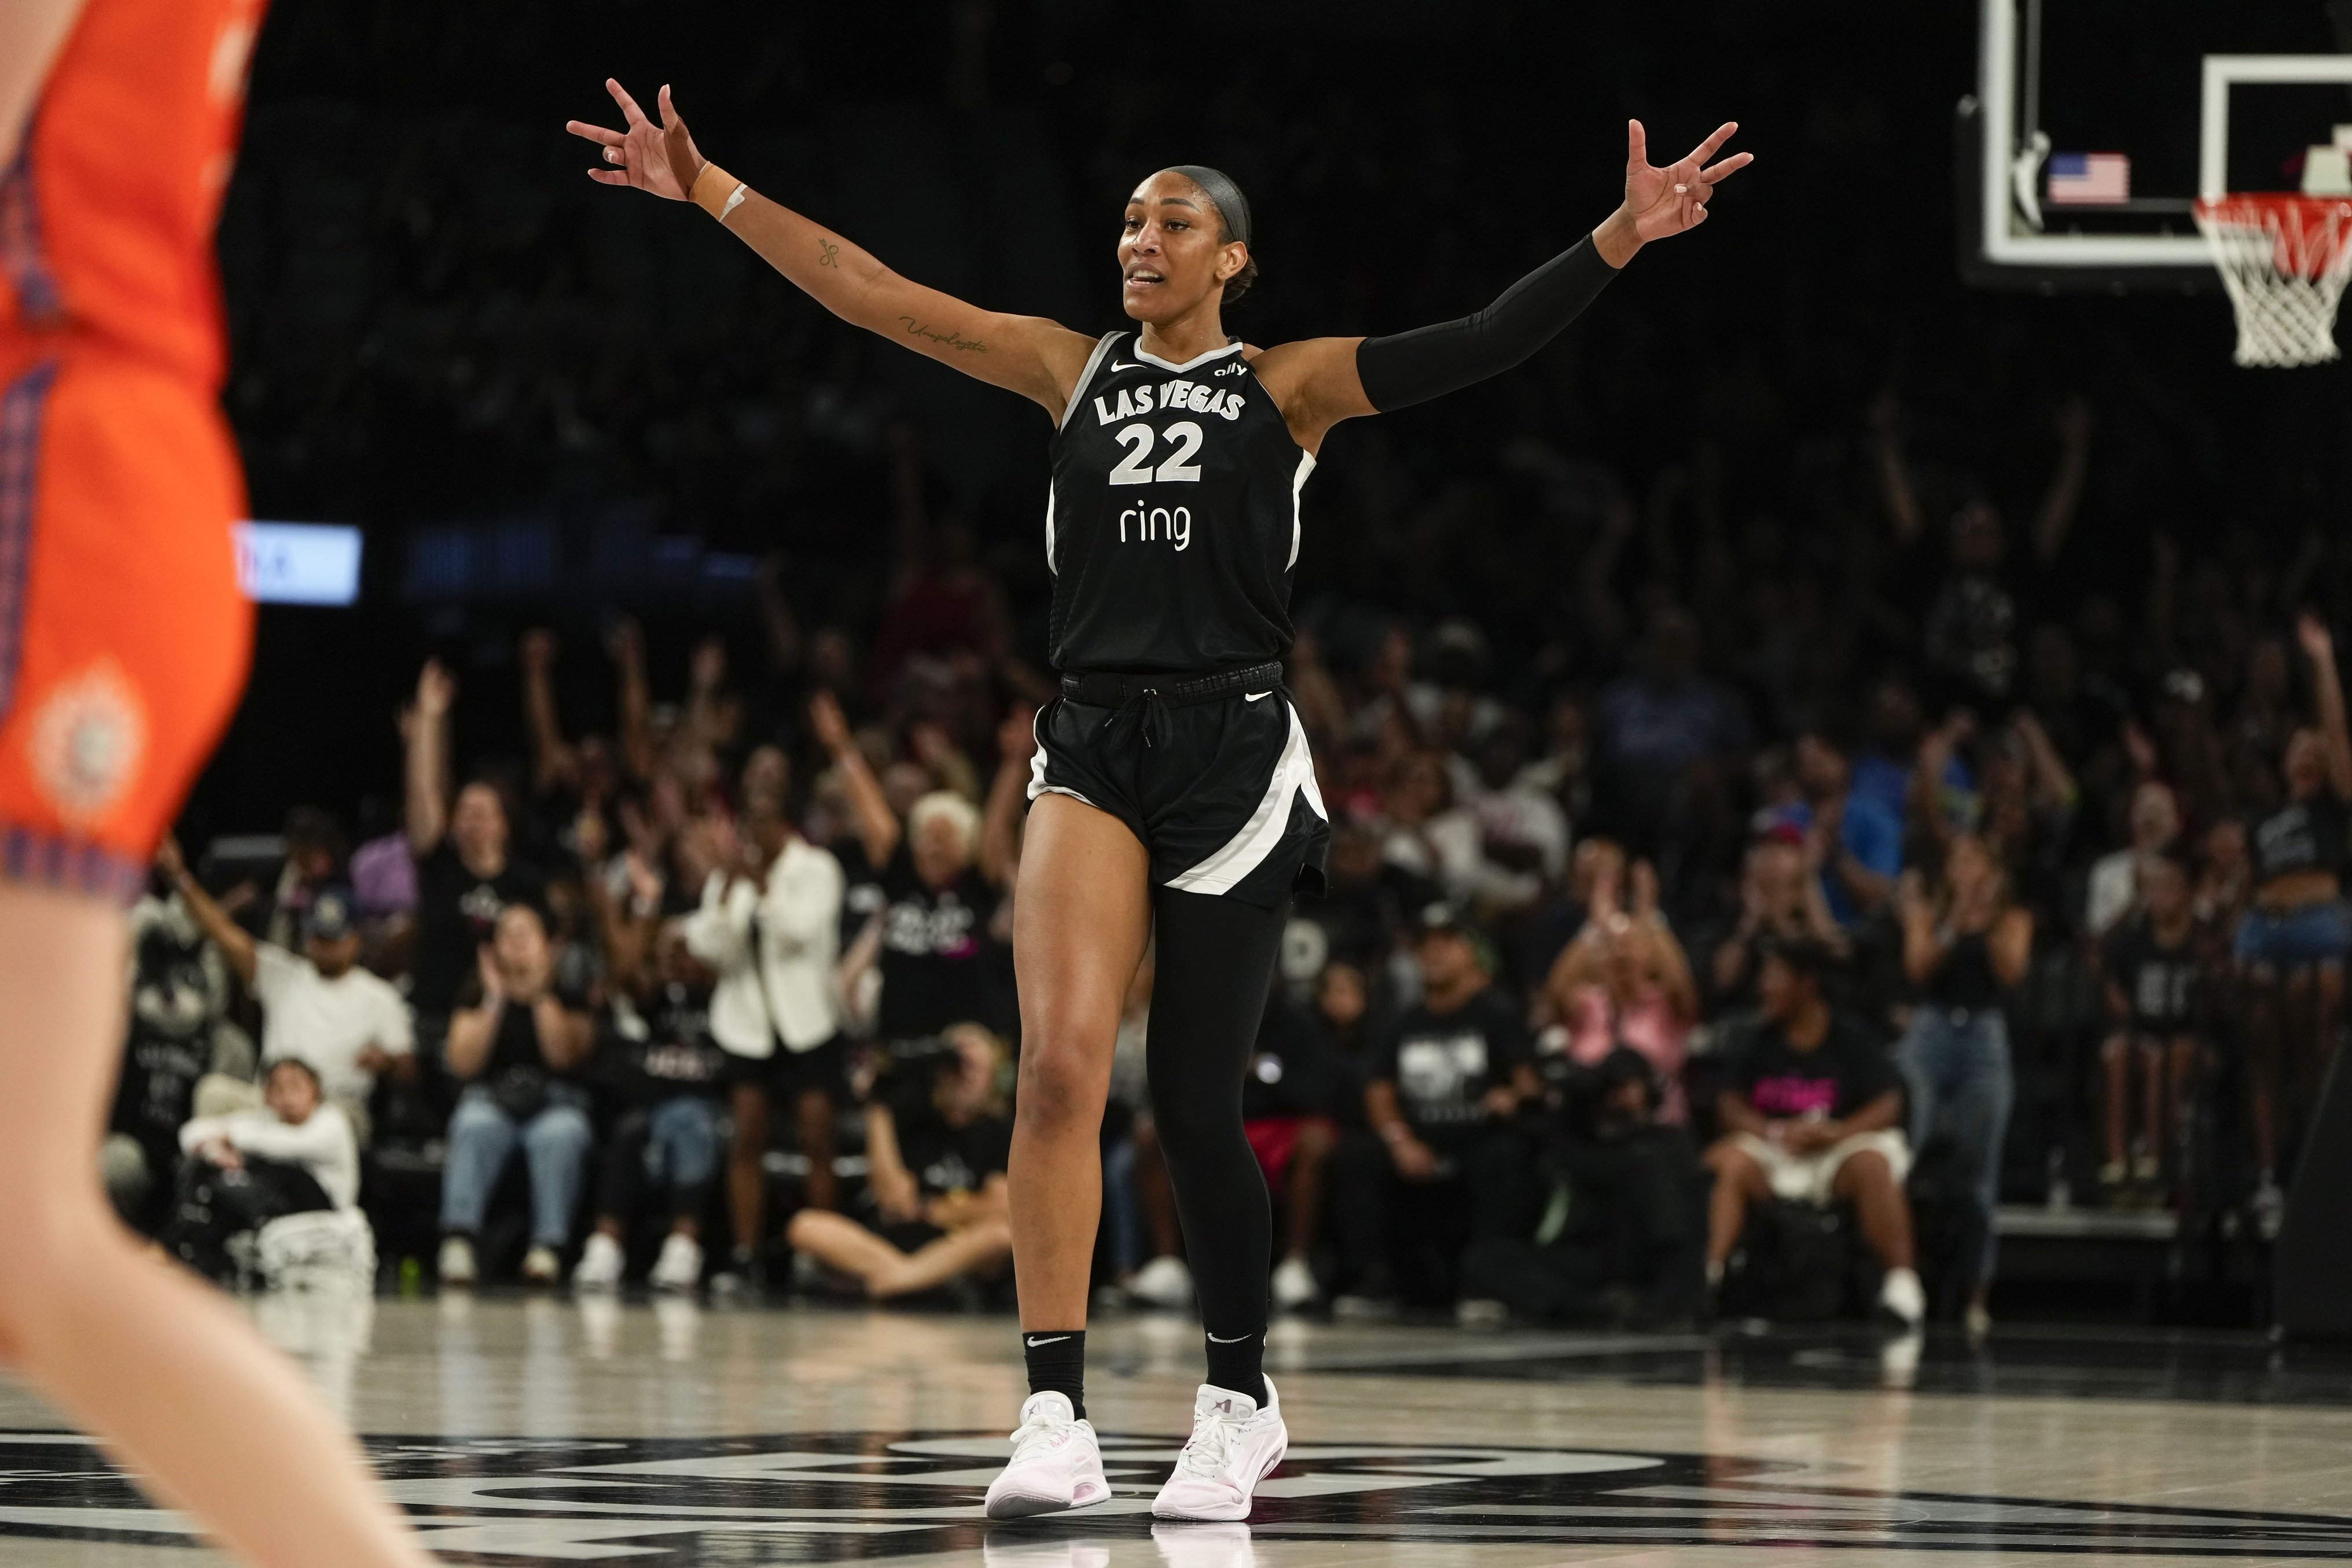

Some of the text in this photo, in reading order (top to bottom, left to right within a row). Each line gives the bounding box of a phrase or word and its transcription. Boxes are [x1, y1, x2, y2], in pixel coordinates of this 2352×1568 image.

[1214, 362, 1248, 377] ally
[1094, 380, 1245, 425] LAS VEGAS
[1109, 422, 1203, 485] 22
[1120, 500, 1191, 551] ring
